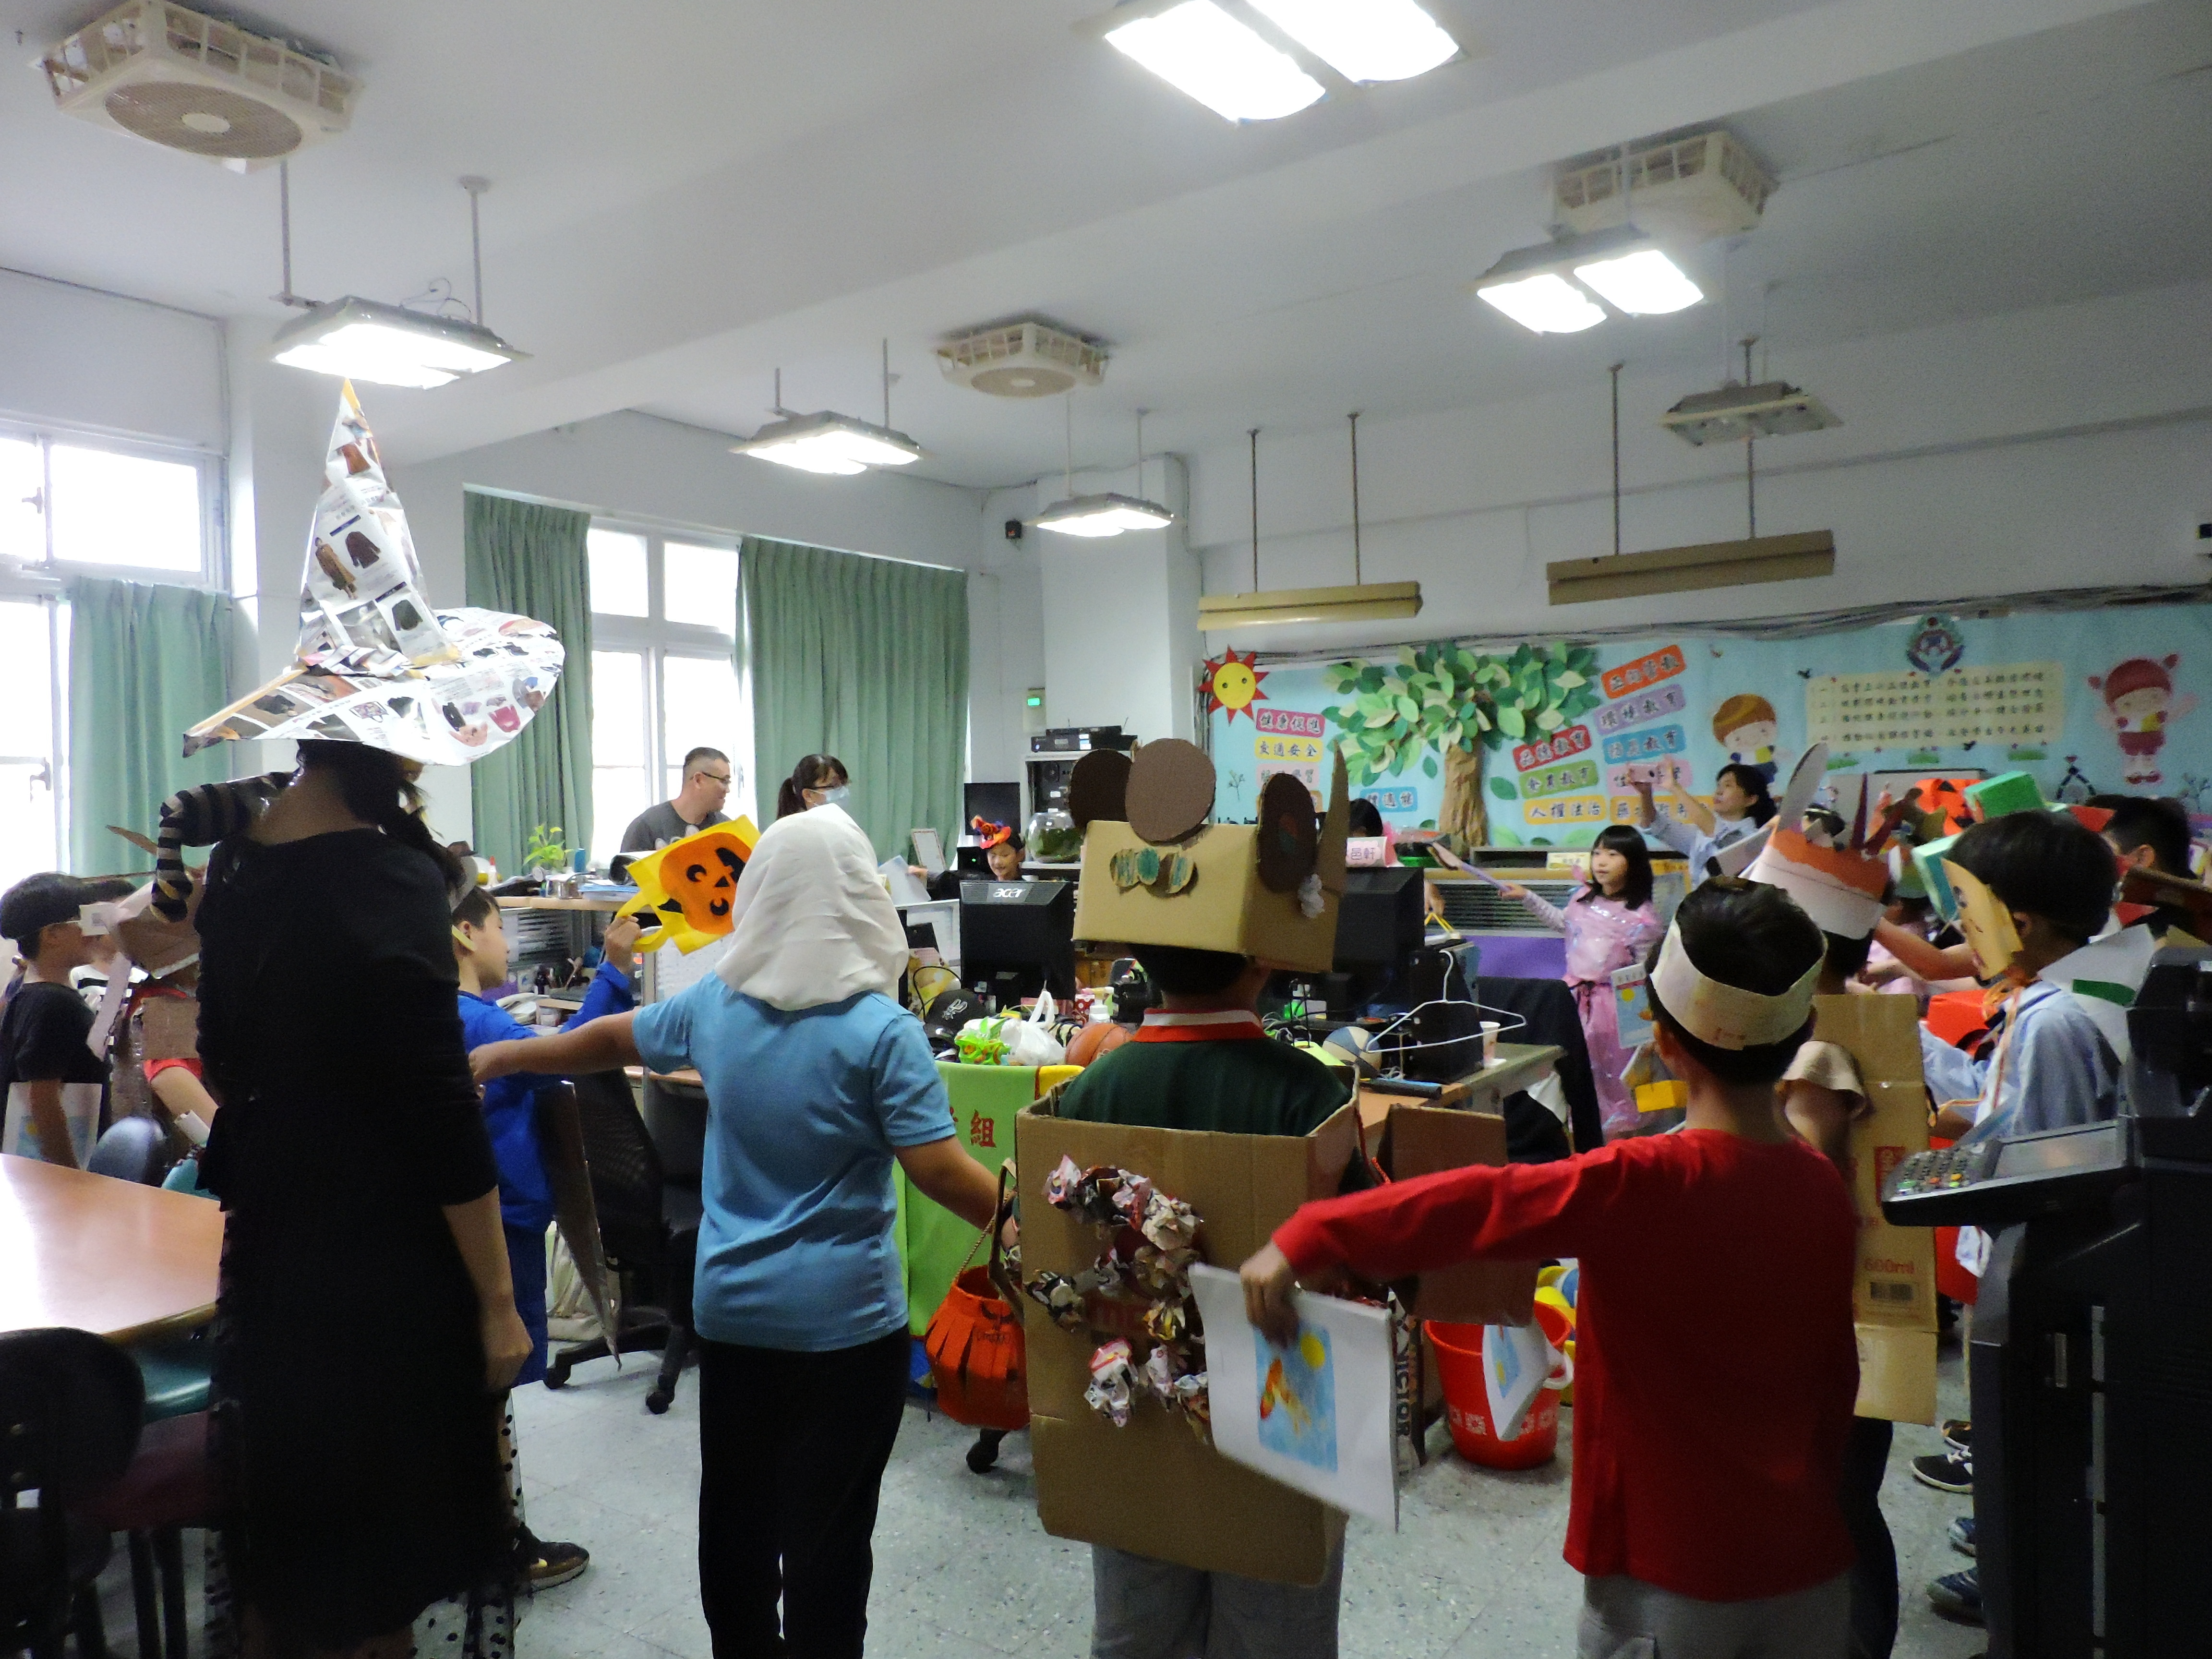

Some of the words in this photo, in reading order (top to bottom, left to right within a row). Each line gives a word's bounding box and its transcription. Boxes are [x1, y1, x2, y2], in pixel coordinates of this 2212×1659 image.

[1260, 741, 1317, 757] 交通安全
[1531, 802, 1600, 818] 人權法治
[993, 888, 1026, 898] acer
